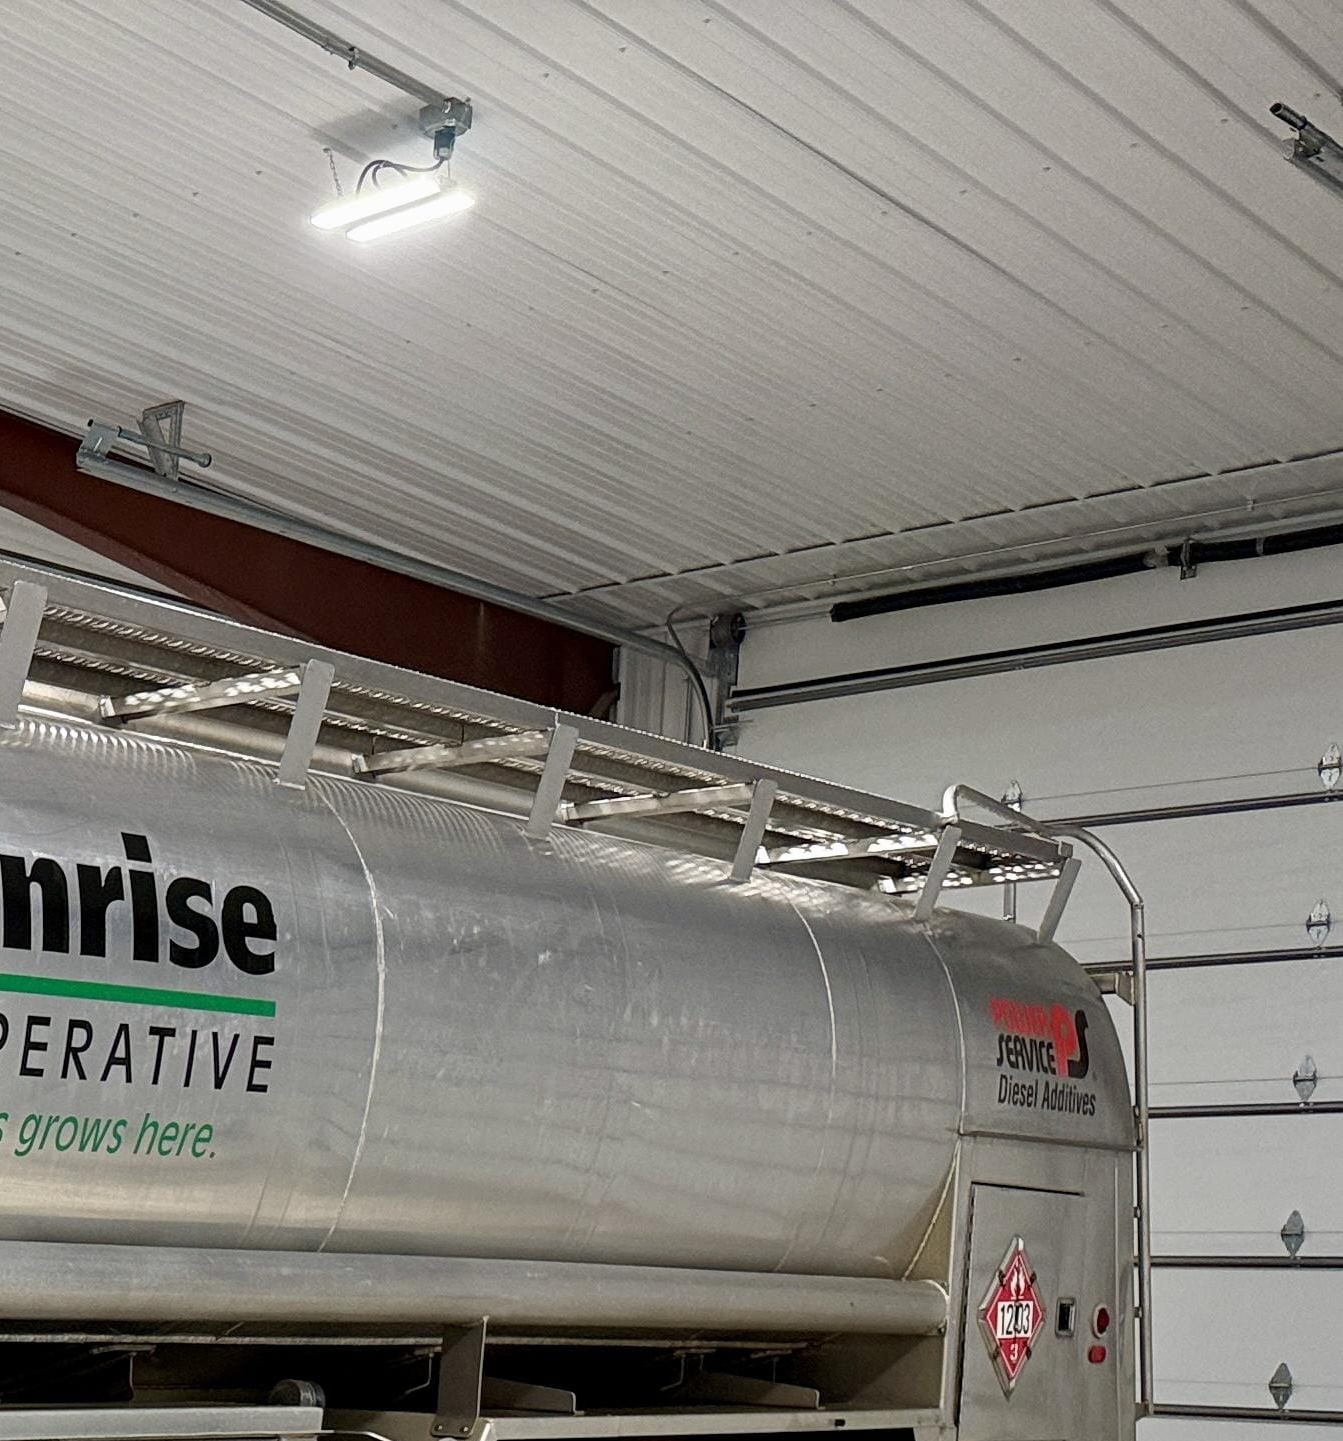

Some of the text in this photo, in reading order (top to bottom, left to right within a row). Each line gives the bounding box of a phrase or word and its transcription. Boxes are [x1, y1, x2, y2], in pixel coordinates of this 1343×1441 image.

[997, 1032, 1057, 1076] SERVICE
[998, 1074, 1097, 1117] Diesel Additives
[13, 1107, 126, 1157] grows
[132, 1112, 217, 1158] here.
[1000, 1302, 1031, 1335] 1203
